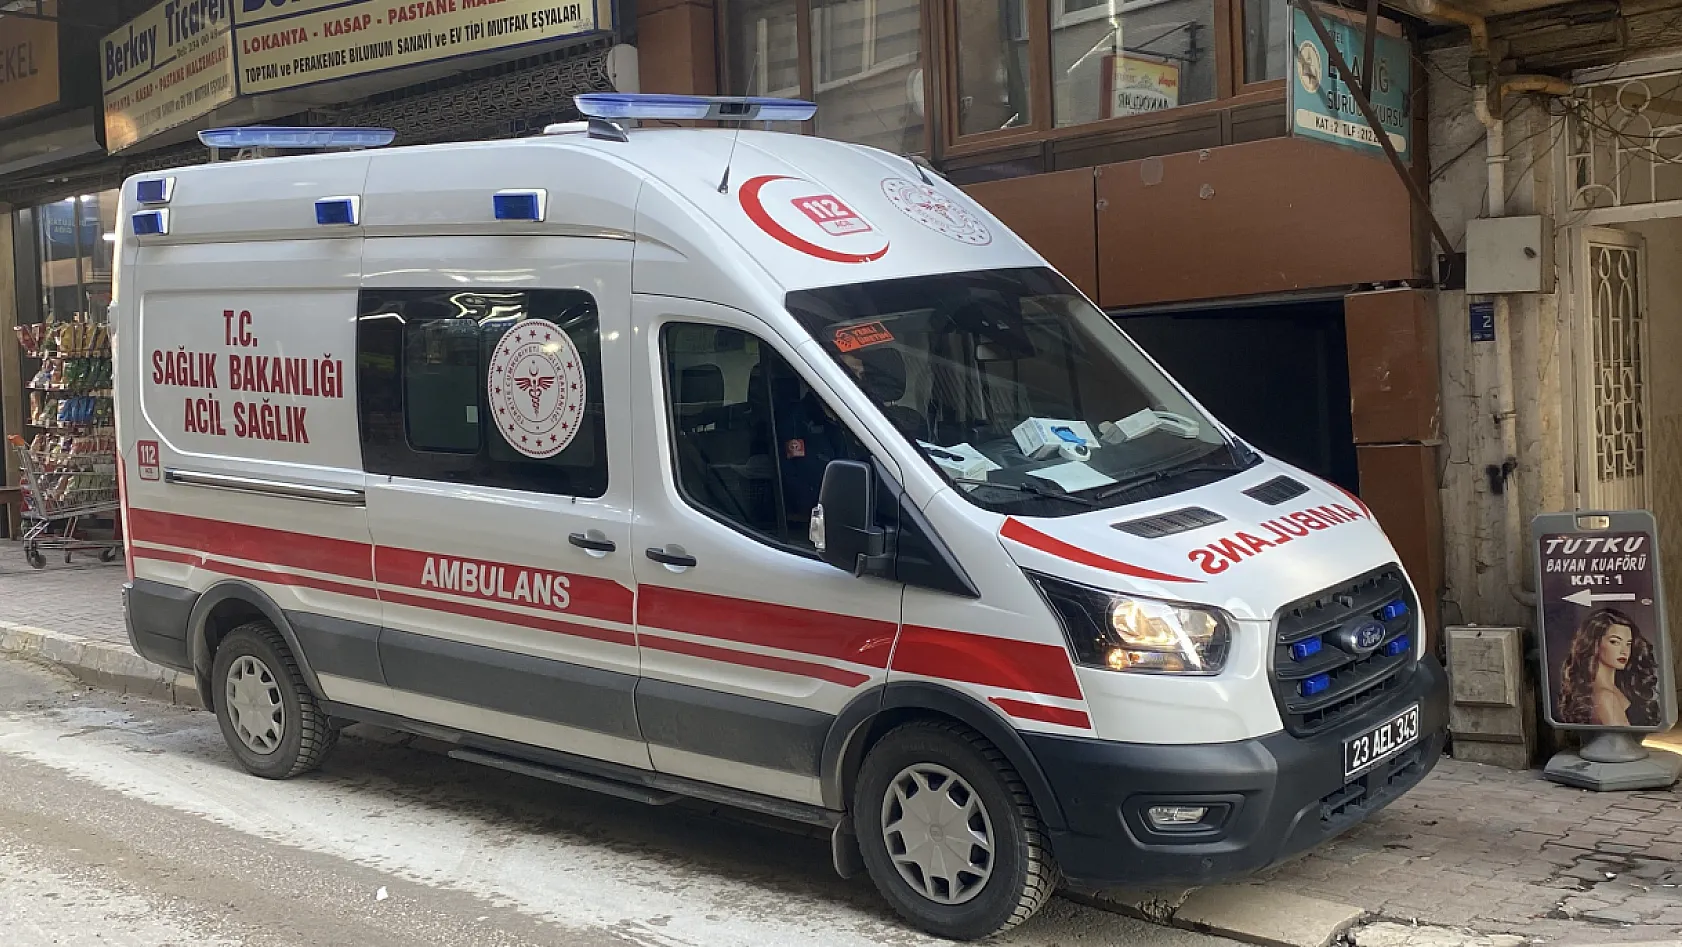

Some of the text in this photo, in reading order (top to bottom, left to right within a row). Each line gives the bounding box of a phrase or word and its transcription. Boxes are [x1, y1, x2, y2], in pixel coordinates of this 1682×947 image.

[242, 27, 308, 55] LOKANTA
[323, 14, 371, 38] KASAP
[387, 0, 456, 25] PASTANE
[245, 63, 278, 83] TOPTAN
[280, 64, 291, 77] ve
[293, 49, 347, 75] PERAKENDE
[349, 40, 394, 63] BİLUMUM
[397, 29, 432, 55] SANAYİ
[434, 32, 447, 47] ve
[449, 27, 463, 45] EV
[465, 18, 485, 41] TİPİ
[487, 13, 529, 37] MUTFAK
[531, 3, 581, 33] EŞYALARI
[104, 25, 157, 82] Berkay
[802, 199, 849, 219] 112
[223, 310, 258, 347] T.C.
[1482, 315, 1493, 328] 2
[152, 345, 344, 399] SAĞLIK BAKANLIĞI
[184, 393, 310, 444] ACİL SAĞLIK
[140, 445, 156, 464] 112
[1546, 536, 1645, 555] TUTKU
[1546, 554, 1647, 573] BAYAN KUAFÖRÜ
[421, 557, 570, 609] AMBULANS
[1571, 574, 1624, 585] KAT: 1
[1352, 710, 1417, 768] 23 AEL 343
